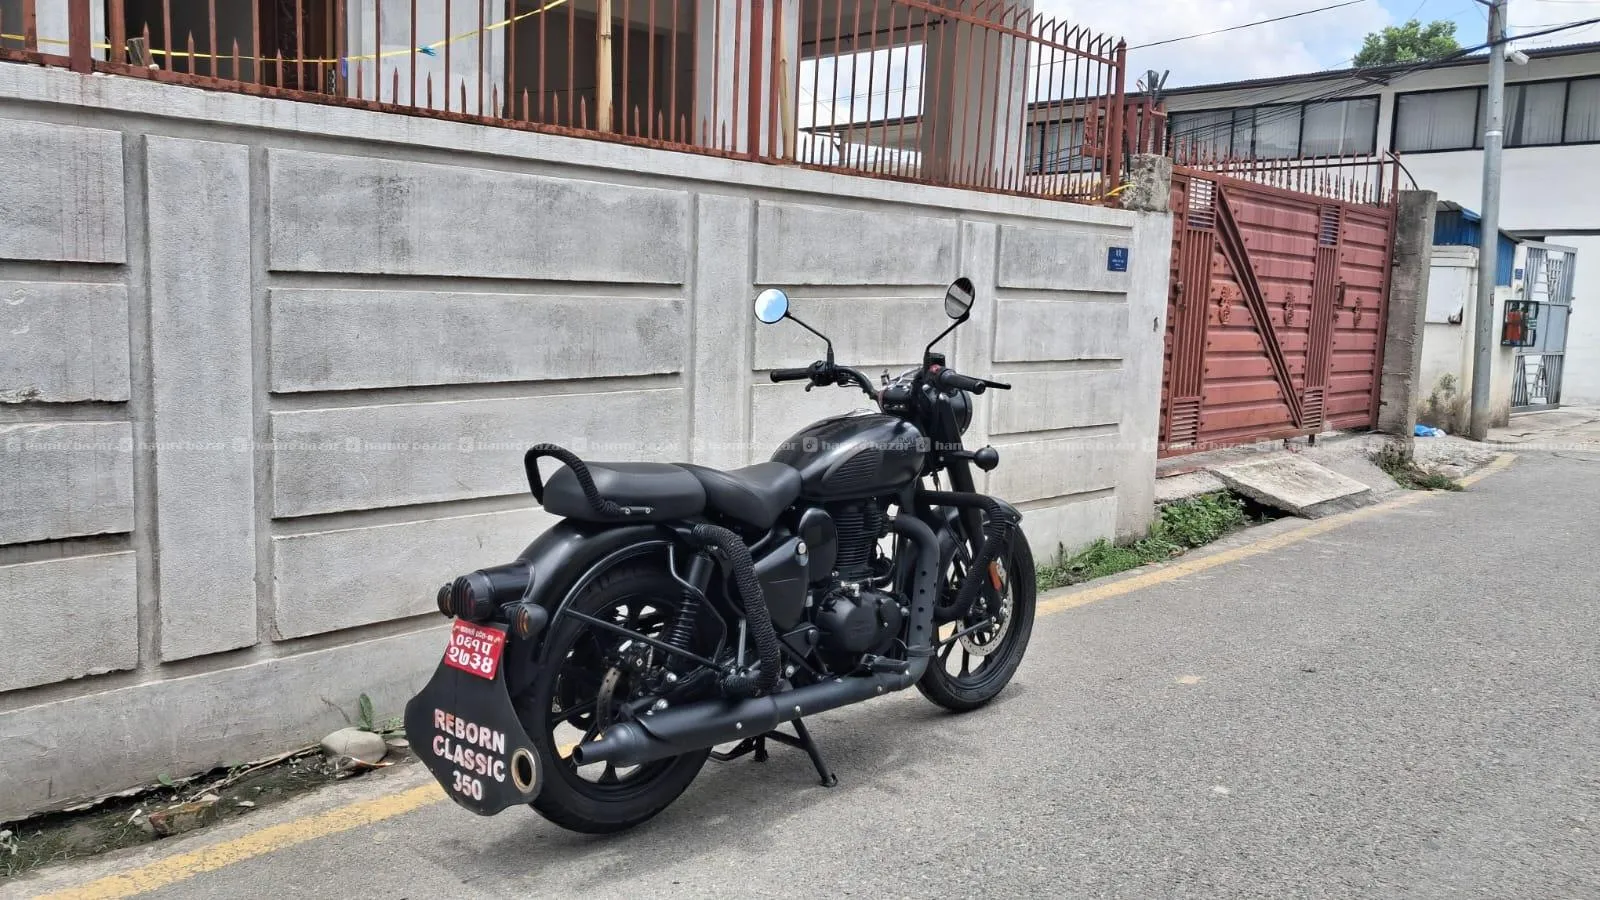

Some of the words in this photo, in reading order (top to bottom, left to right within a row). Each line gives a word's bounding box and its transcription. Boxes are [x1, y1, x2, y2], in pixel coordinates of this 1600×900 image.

[446, 646, 493, 674] २७३४
[434, 708, 505, 755] REBORN
[433, 735, 505, 783] CLASSIC
[453, 770, 483, 801] 350
